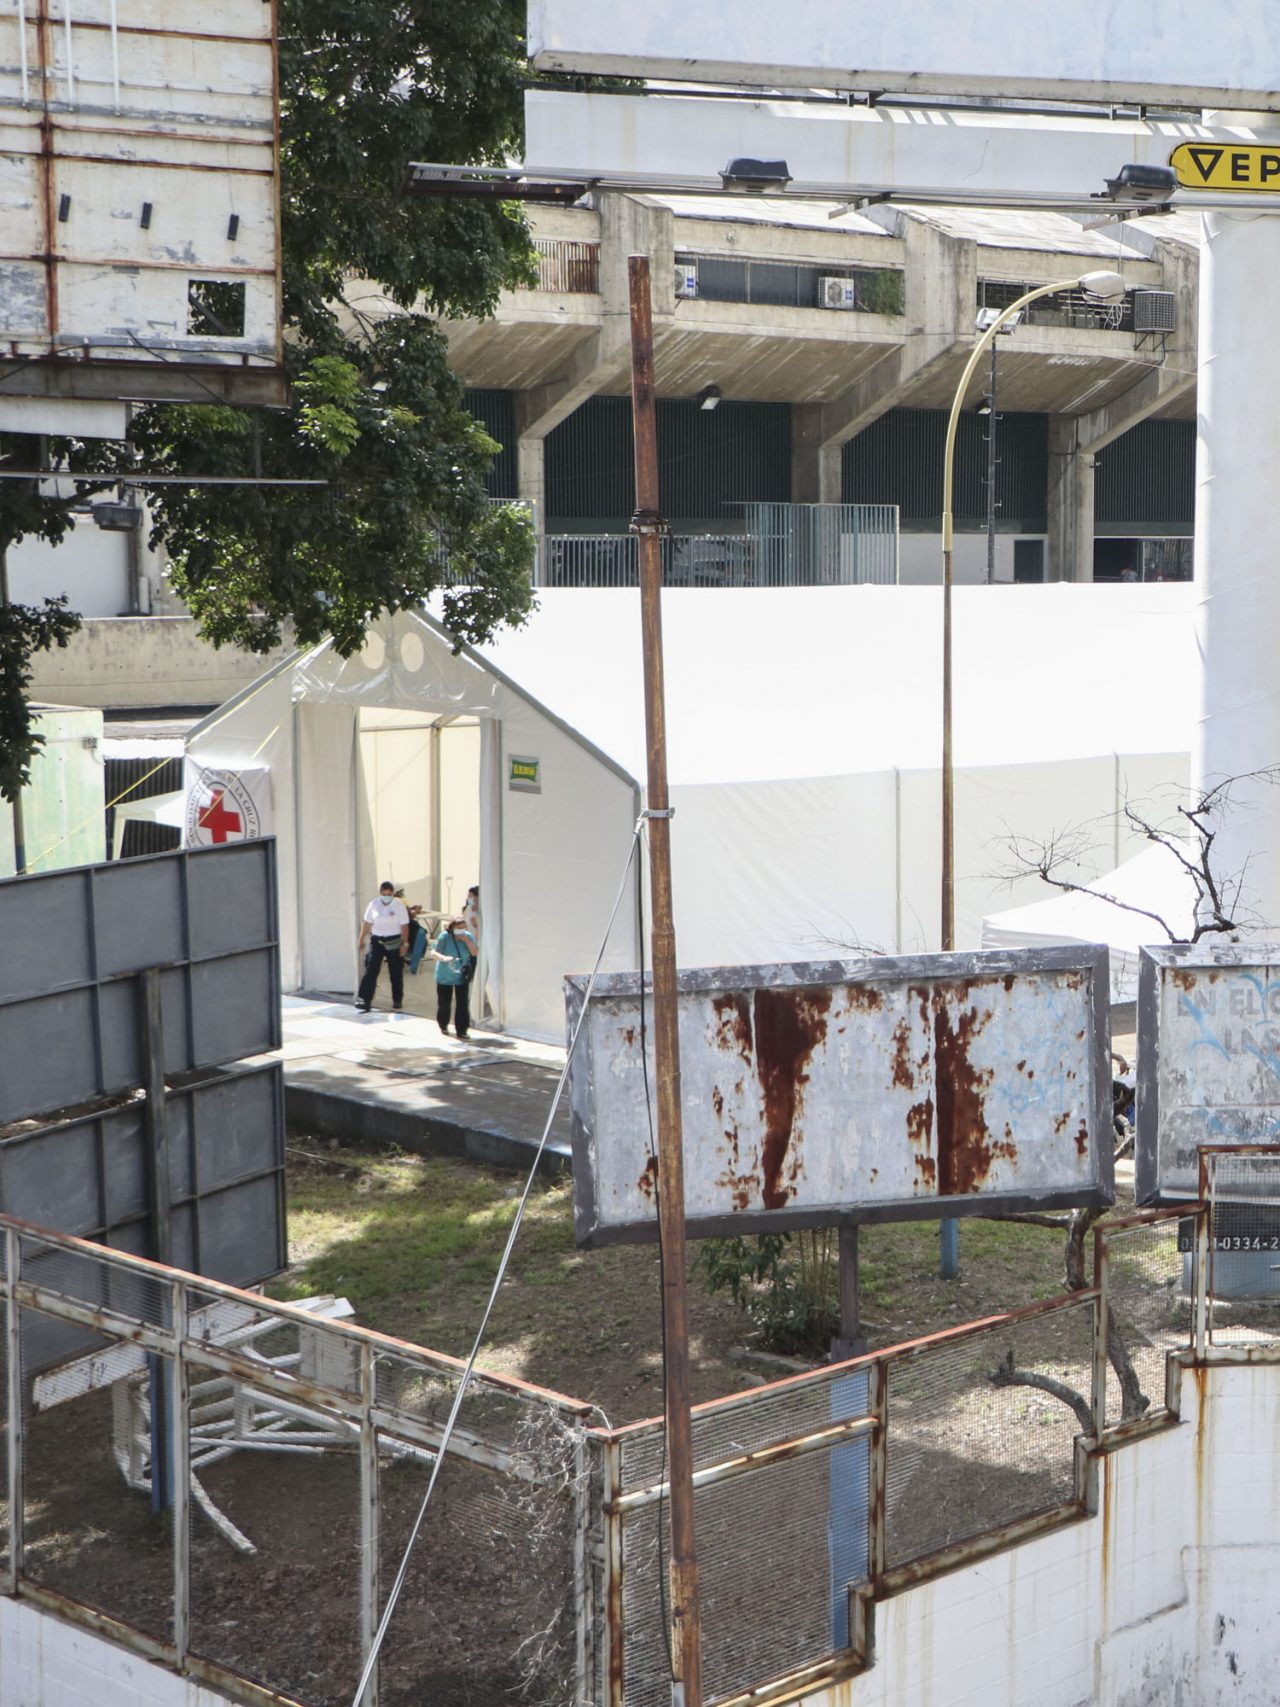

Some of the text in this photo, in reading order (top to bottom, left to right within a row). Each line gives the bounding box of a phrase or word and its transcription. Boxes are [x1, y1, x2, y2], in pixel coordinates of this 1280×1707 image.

[242, 800, 257, 825] CRUZ
[1176, 989, 1217, 1017] EN
[1228, 988, 1258, 1015] EL
